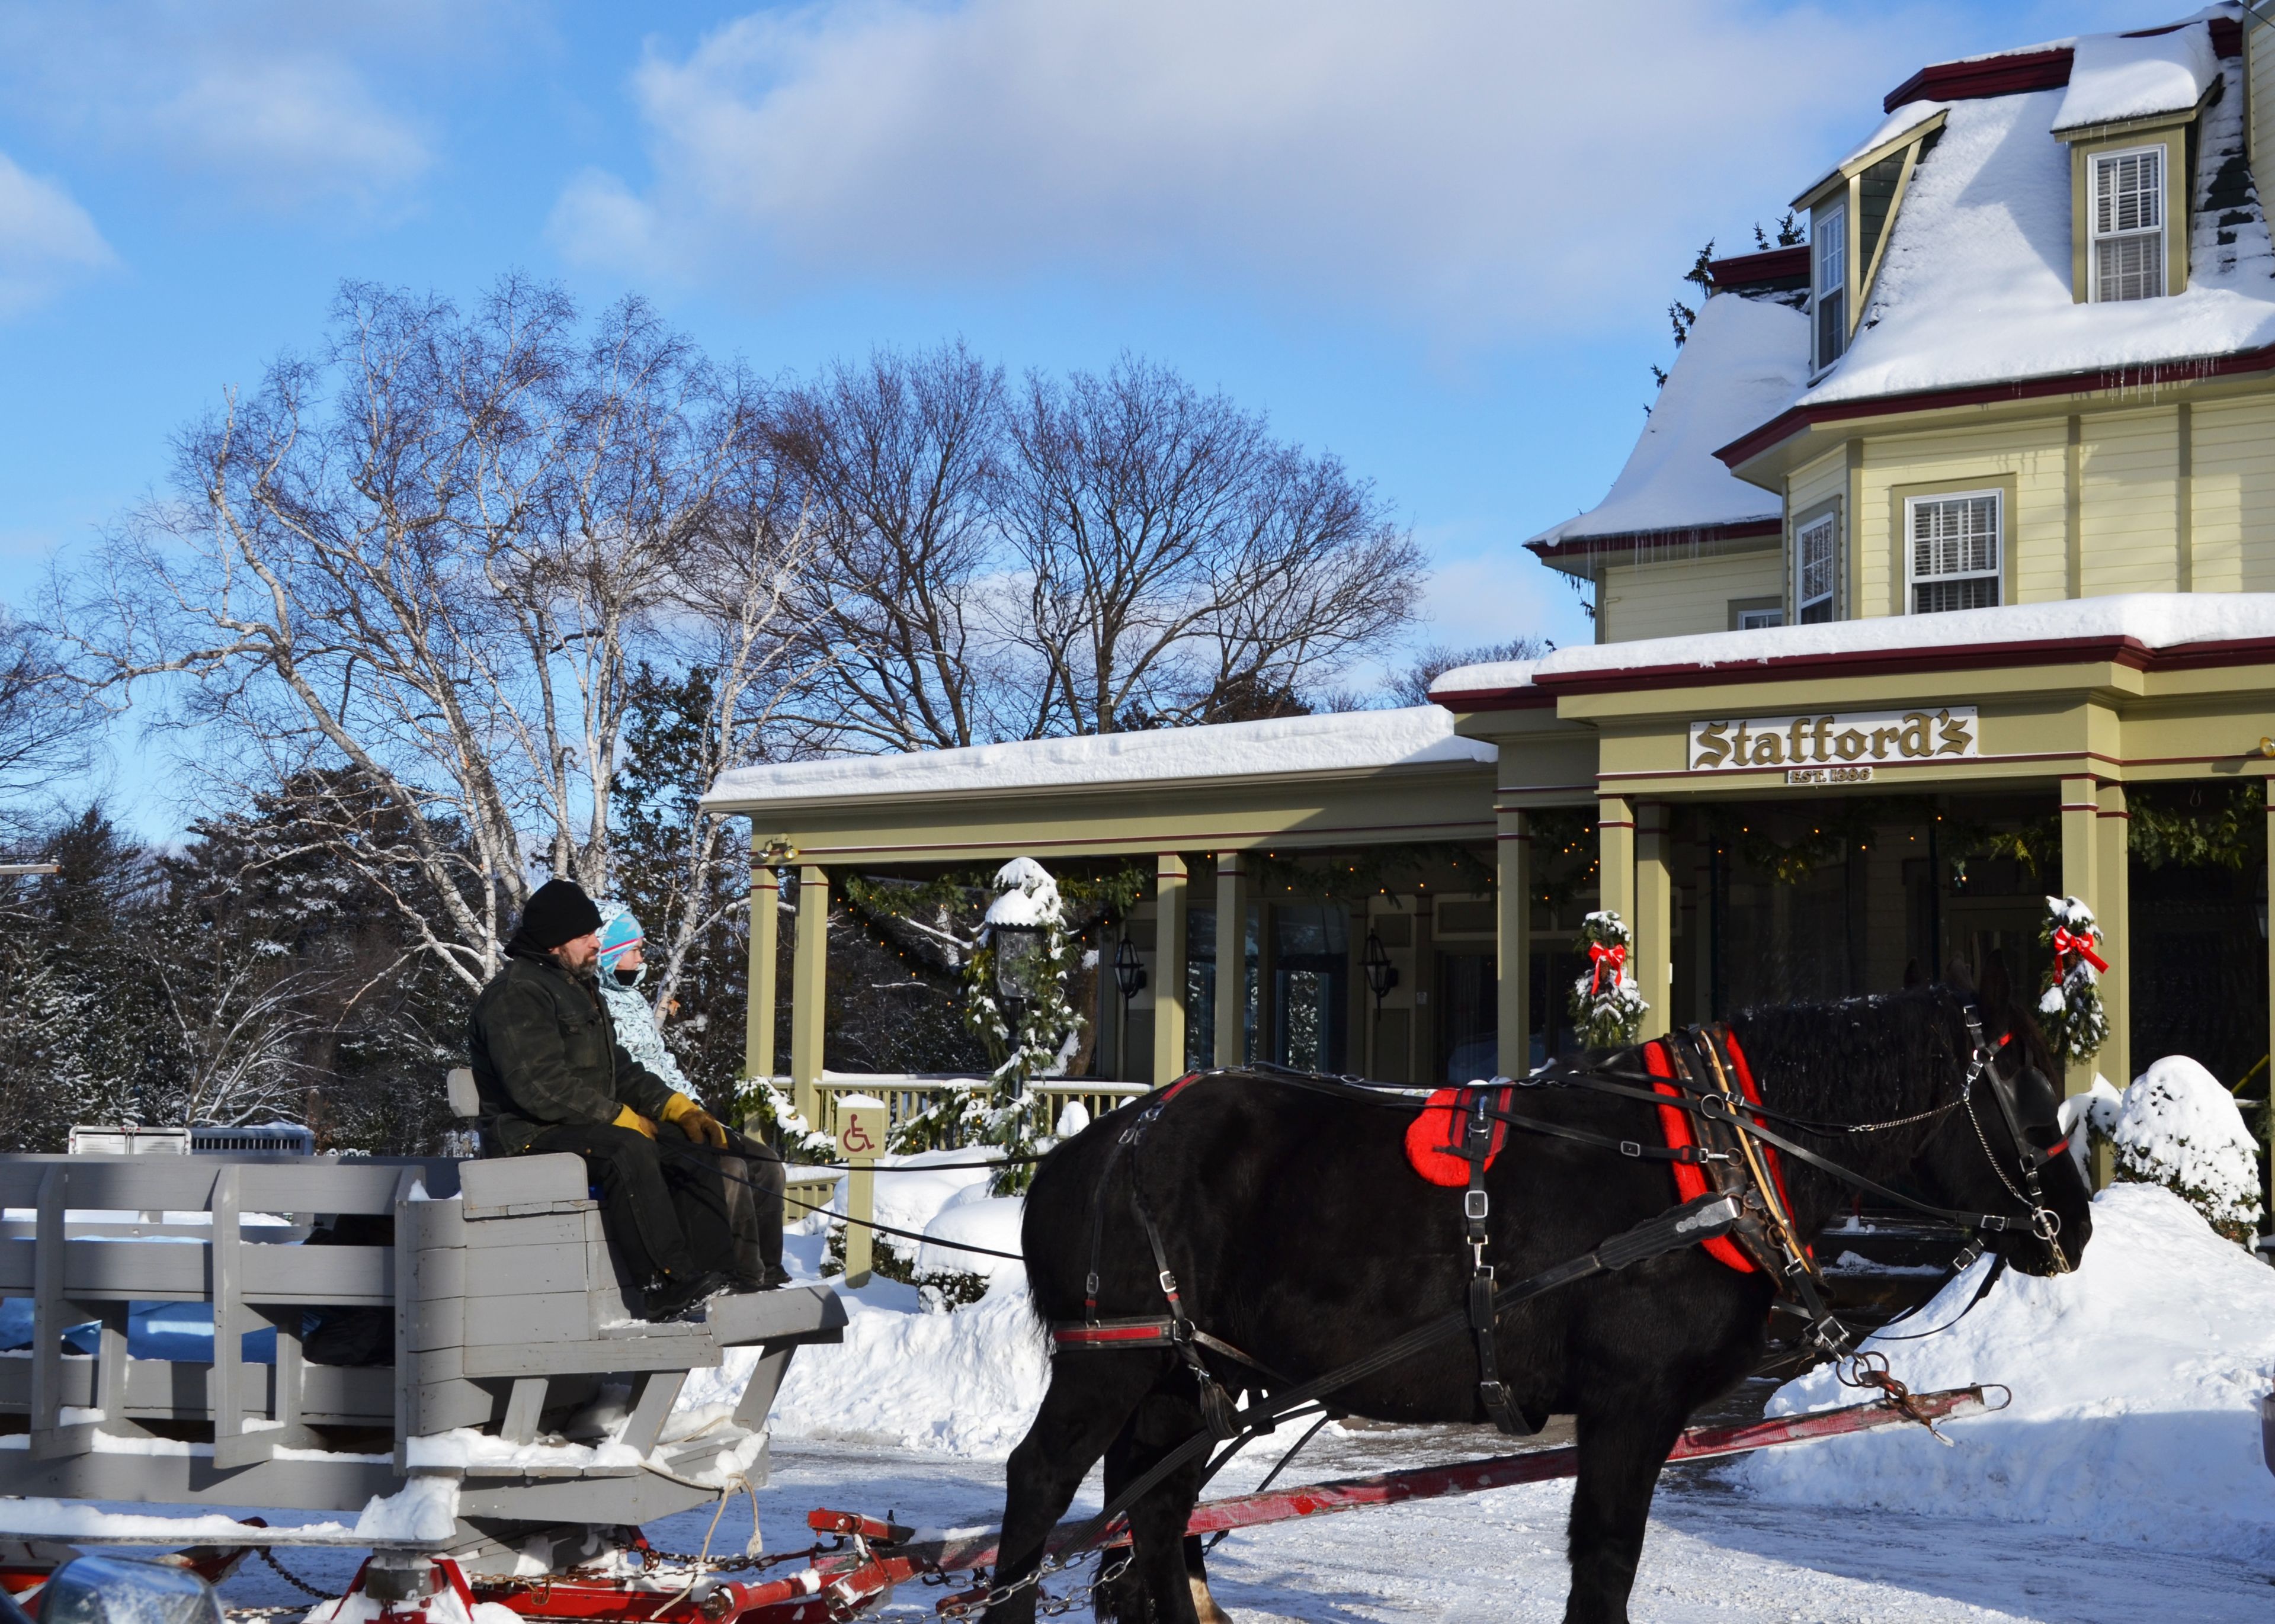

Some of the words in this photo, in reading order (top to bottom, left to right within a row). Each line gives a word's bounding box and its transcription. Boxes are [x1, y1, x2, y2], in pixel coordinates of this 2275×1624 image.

[1694, 709, 1973, 769] Stafford's
[1791, 770, 1827, 783] EST.
[1830, 768, 1871, 781] 1886
